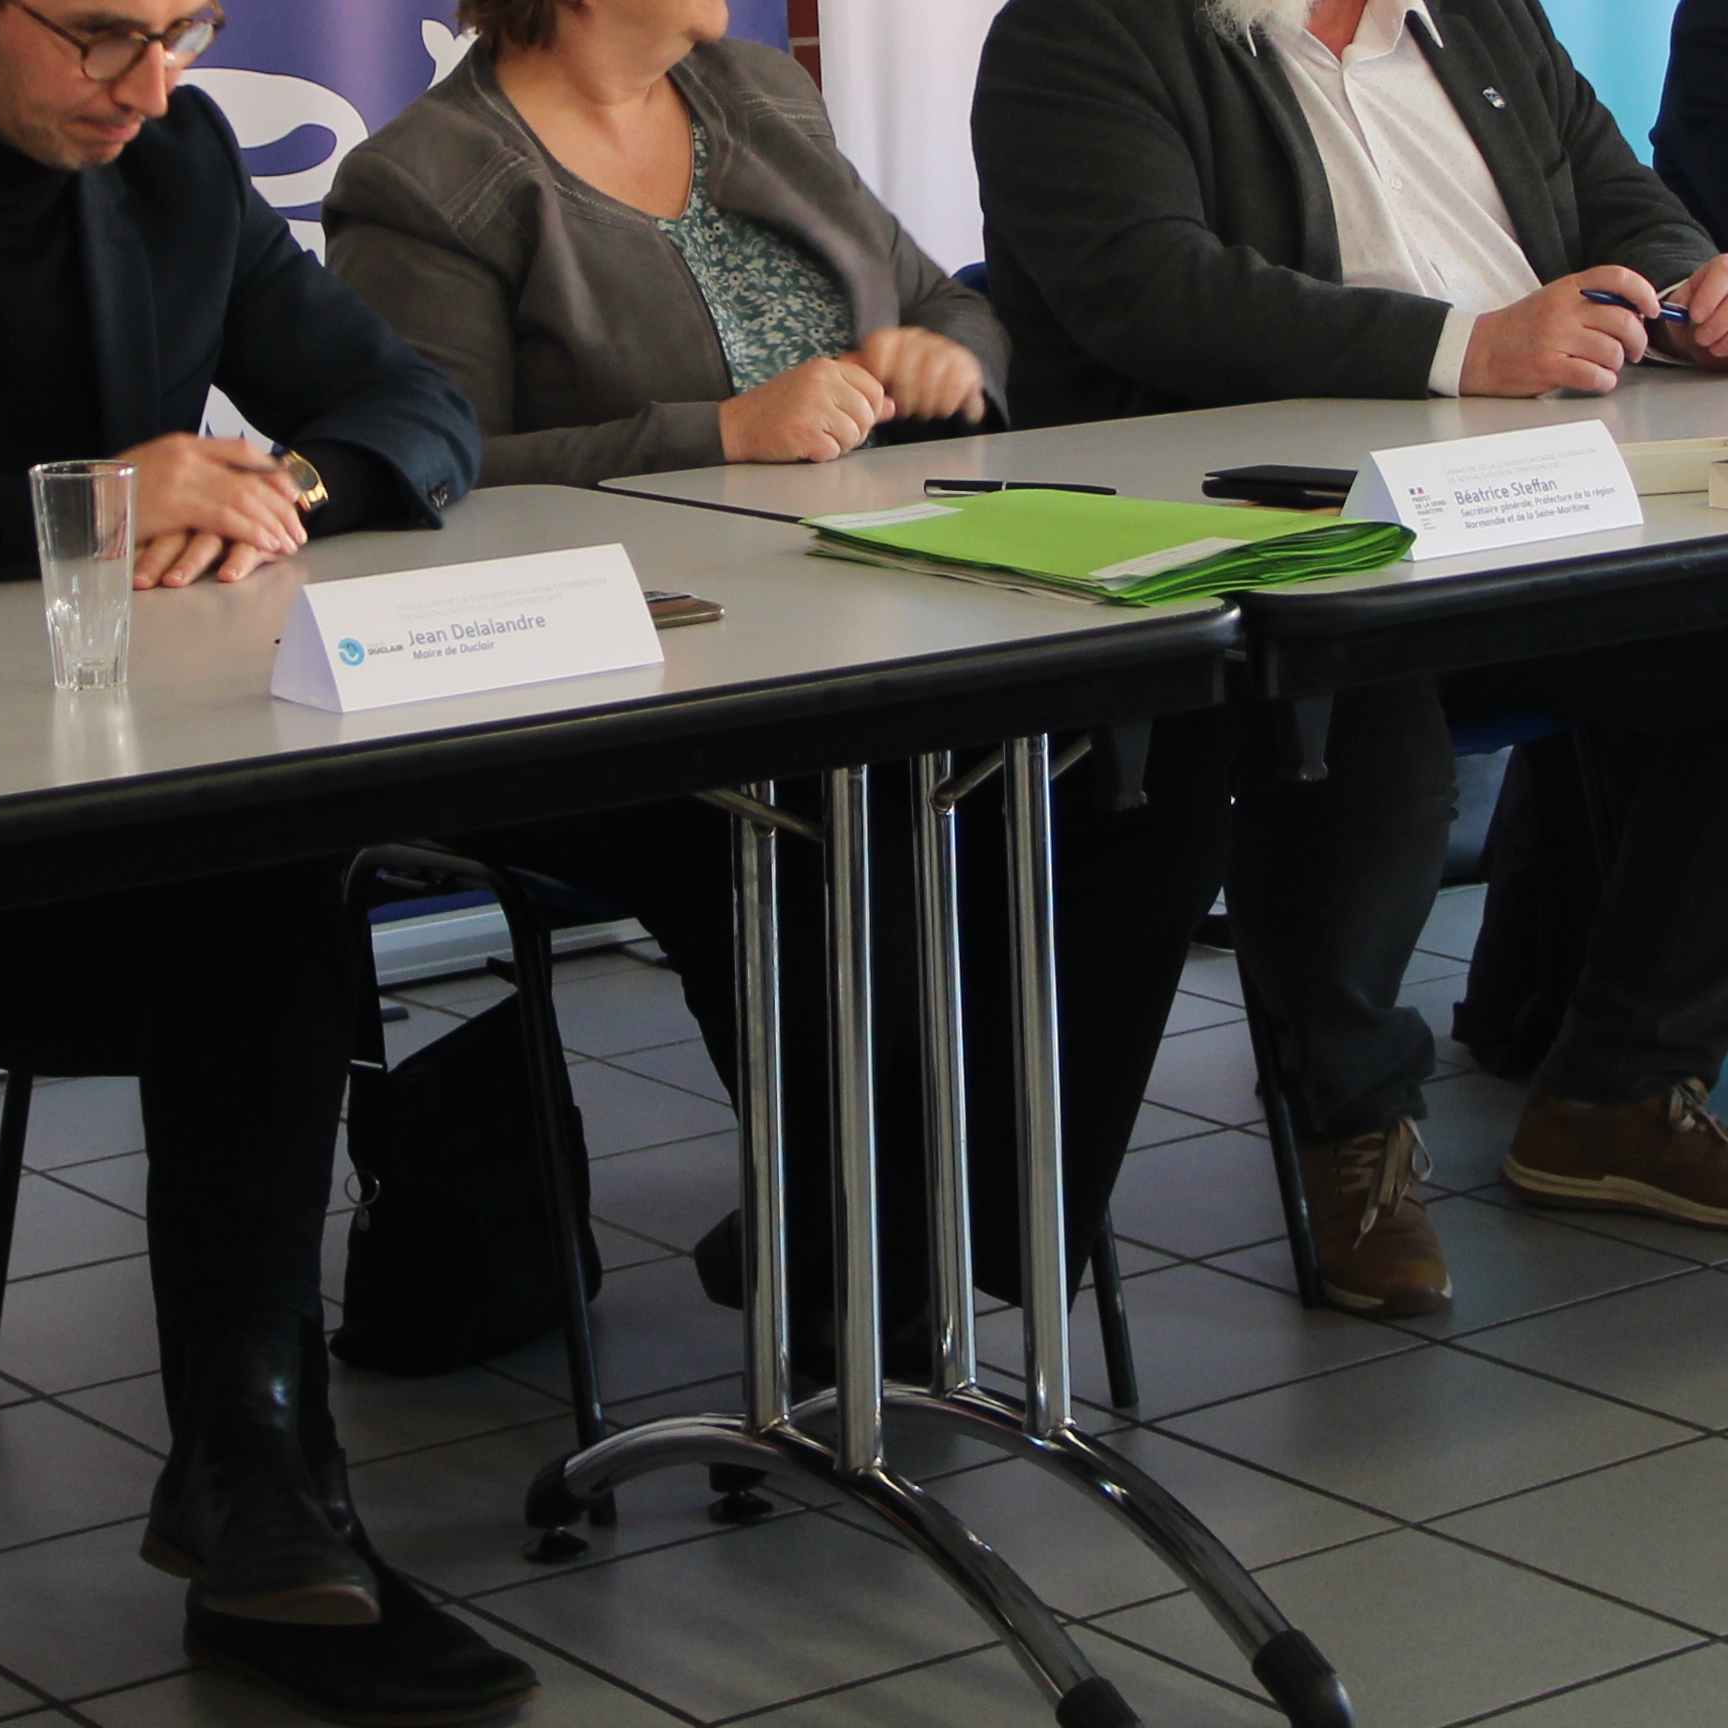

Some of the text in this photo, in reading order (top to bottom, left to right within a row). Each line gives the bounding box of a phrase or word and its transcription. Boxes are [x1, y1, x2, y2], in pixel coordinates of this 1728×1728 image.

[1454, 478, 1557, 505] Béatrice Steffan
[1461, 502, 1499, 517] Secrétaire
[1534, 491, 1572, 506] Préfecture
[1592, 485, 1615, 500] région
[408, 628, 448, 648] Jean
[452, 613, 546, 640] Delalandre
[413, 638, 495, 661] Maire de Duclair
